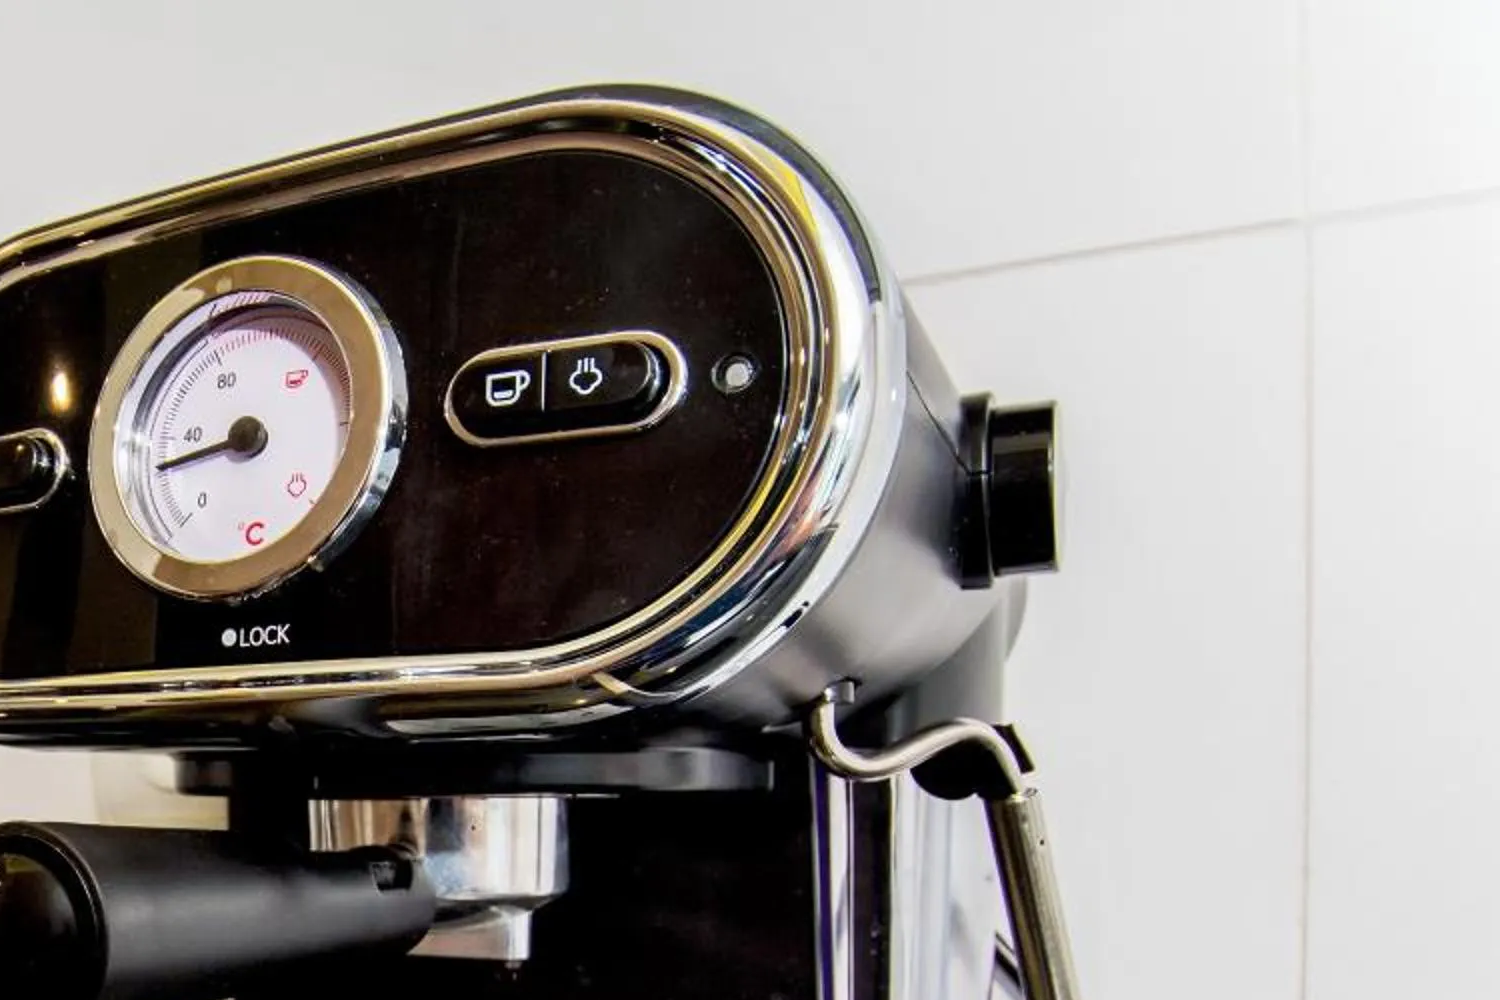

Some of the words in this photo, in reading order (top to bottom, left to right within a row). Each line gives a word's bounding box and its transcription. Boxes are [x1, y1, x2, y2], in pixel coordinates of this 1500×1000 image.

[217, 372, 236, 389] 80
[183, 426, 202, 442] 40
[197, 492, 207, 508] 0
[239, 623, 290, 647] LOCK
